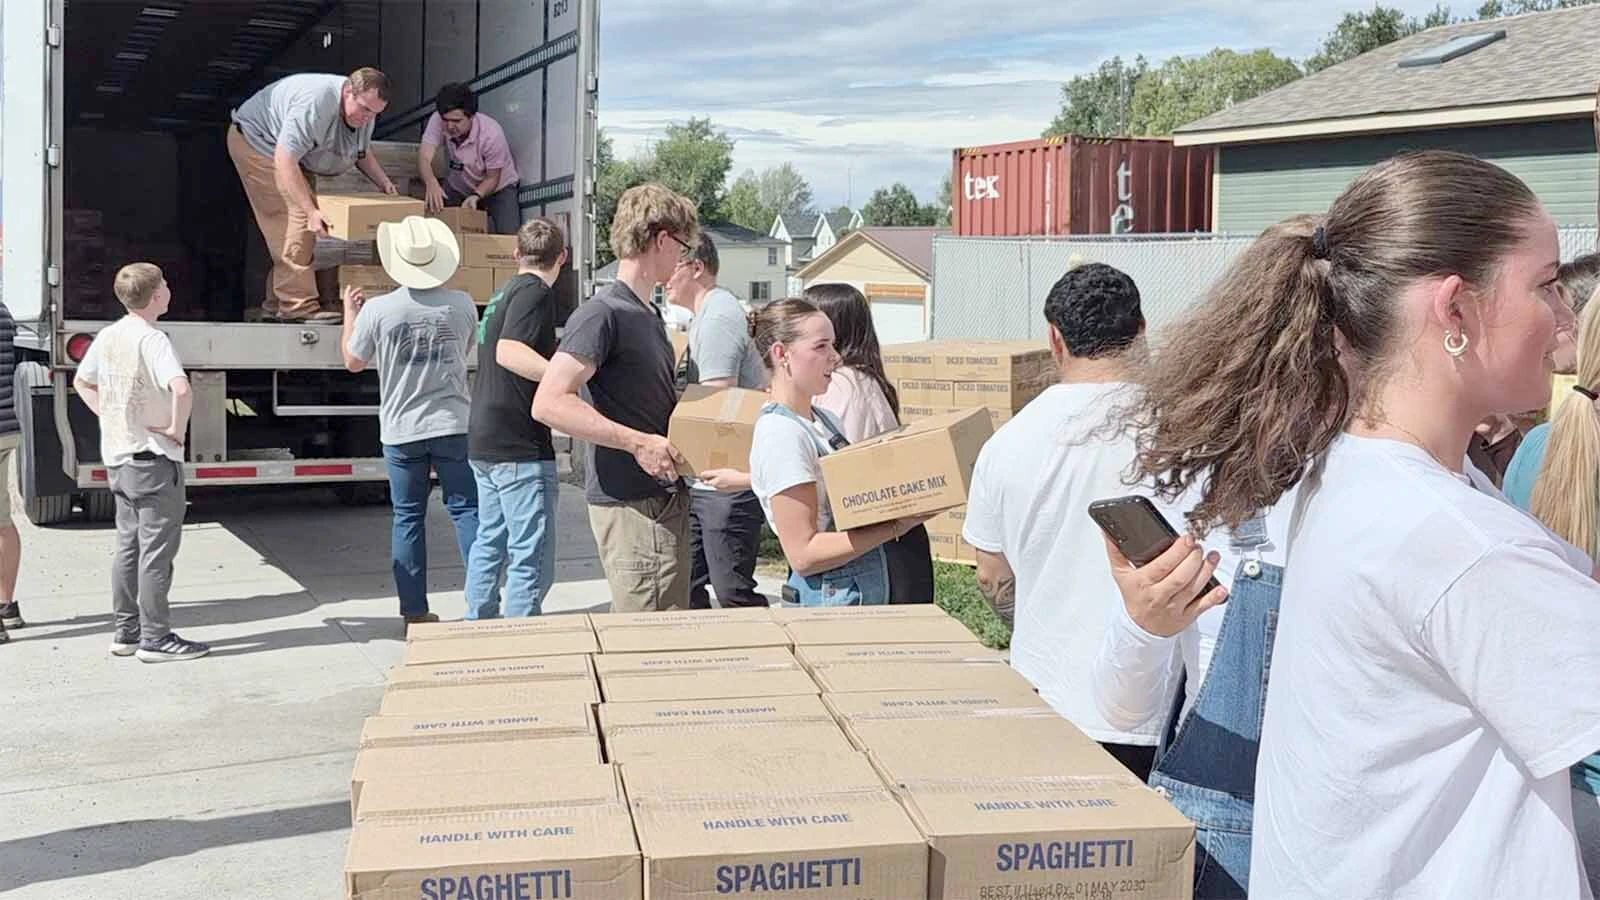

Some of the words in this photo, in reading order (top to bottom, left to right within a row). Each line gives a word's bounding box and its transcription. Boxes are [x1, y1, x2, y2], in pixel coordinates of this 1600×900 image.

[964, 171, 1000, 200] tex
[902, 355, 932, 365] TOMATOES
[946, 356, 964, 365] DICED
[966, 356, 999, 365] TOMATOES
[902, 381, 919, 390] DICED
[921, 382, 951, 391] TOMATOES
[957, 383, 975, 391] DICED
[976, 383, 1009, 392] TOMATOES
[842, 486, 898, 509] CHOCOLATE
[899, 480, 926, 496] CAKE
[927, 474, 948, 489] MIX
[413, 723, 447, 731] CARE
[451, 719, 484, 728] WITH
[488, 716, 539, 725] HANDLE
[974, 800, 1036, 811] HANDLE
[1035, 799, 1075, 808] WITH
[1077, 798, 1117, 808] CARE
[703, 815, 766, 830] HANDLE
[767, 814, 808, 827] WITH
[811, 813, 852, 824] CARE
[419, 831, 483, 844] HANDLE
[487, 828, 527, 840] WITH
[532, 825, 575, 837] CARE
[996, 839, 1133, 871] SPAGHETTI
[716, 857, 861, 894] SPAGHETTI
[421, 869, 571, 900] SPAGHETTI
[979, 885, 1011, 898] BEST
[1023, 883, 1052, 898] Used
[1075, 881, 1088, 896] 01
[1090, 880, 1118, 895] MAY
[1119, 879, 1146, 893] 2030
